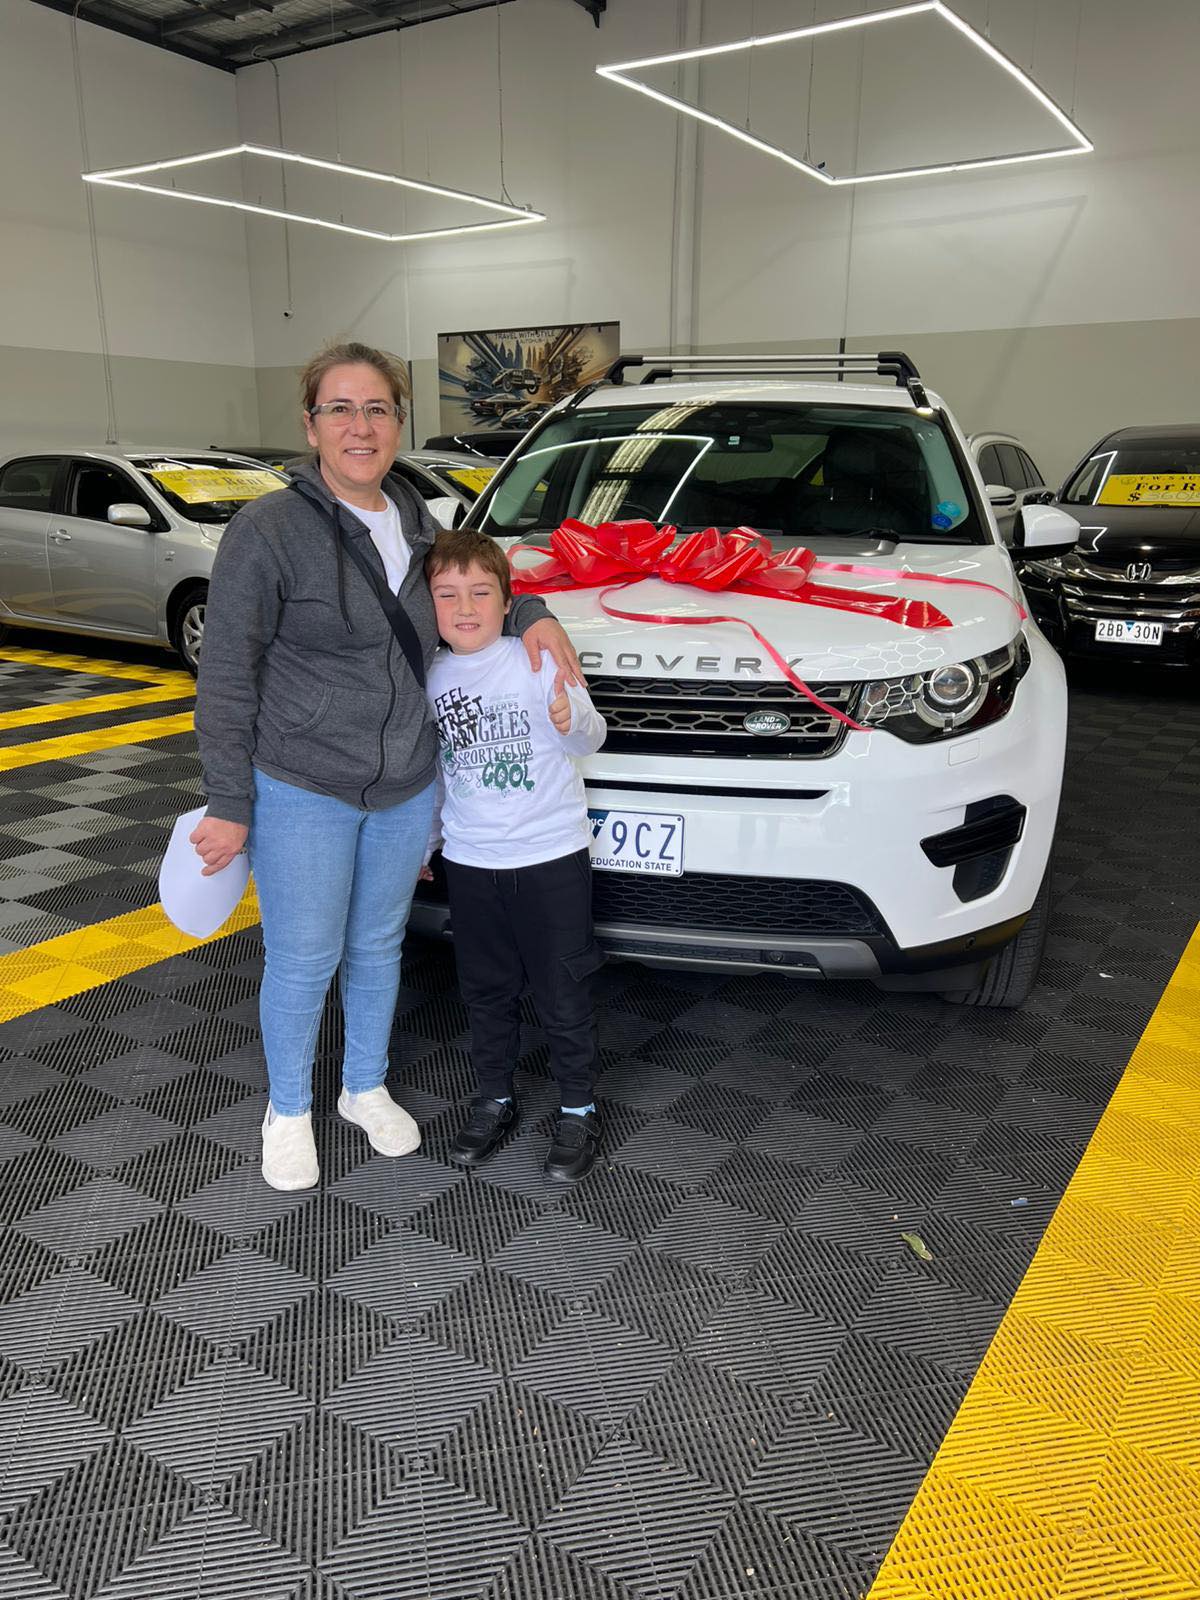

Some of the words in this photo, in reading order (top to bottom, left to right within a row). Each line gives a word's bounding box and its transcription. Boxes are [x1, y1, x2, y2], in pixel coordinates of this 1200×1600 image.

[495, 332, 518, 340] TRAVEL
[1135, 482, 1175, 491] For
[1127, 491, 1141, 503] $
[1098, 622, 1123, 638] 2BB
[435, 687, 469, 717] FEEL
[754, 715, 776, 723] LAND
[755, 722, 782, 730] ROVER
[451, 721, 479, 751] ART
[482, 761, 535, 792] COOL
[612, 820, 677, 861] 9CZ
[590, 856, 642, 869] EDUCATION
[644, 861, 672, 872] STATE
